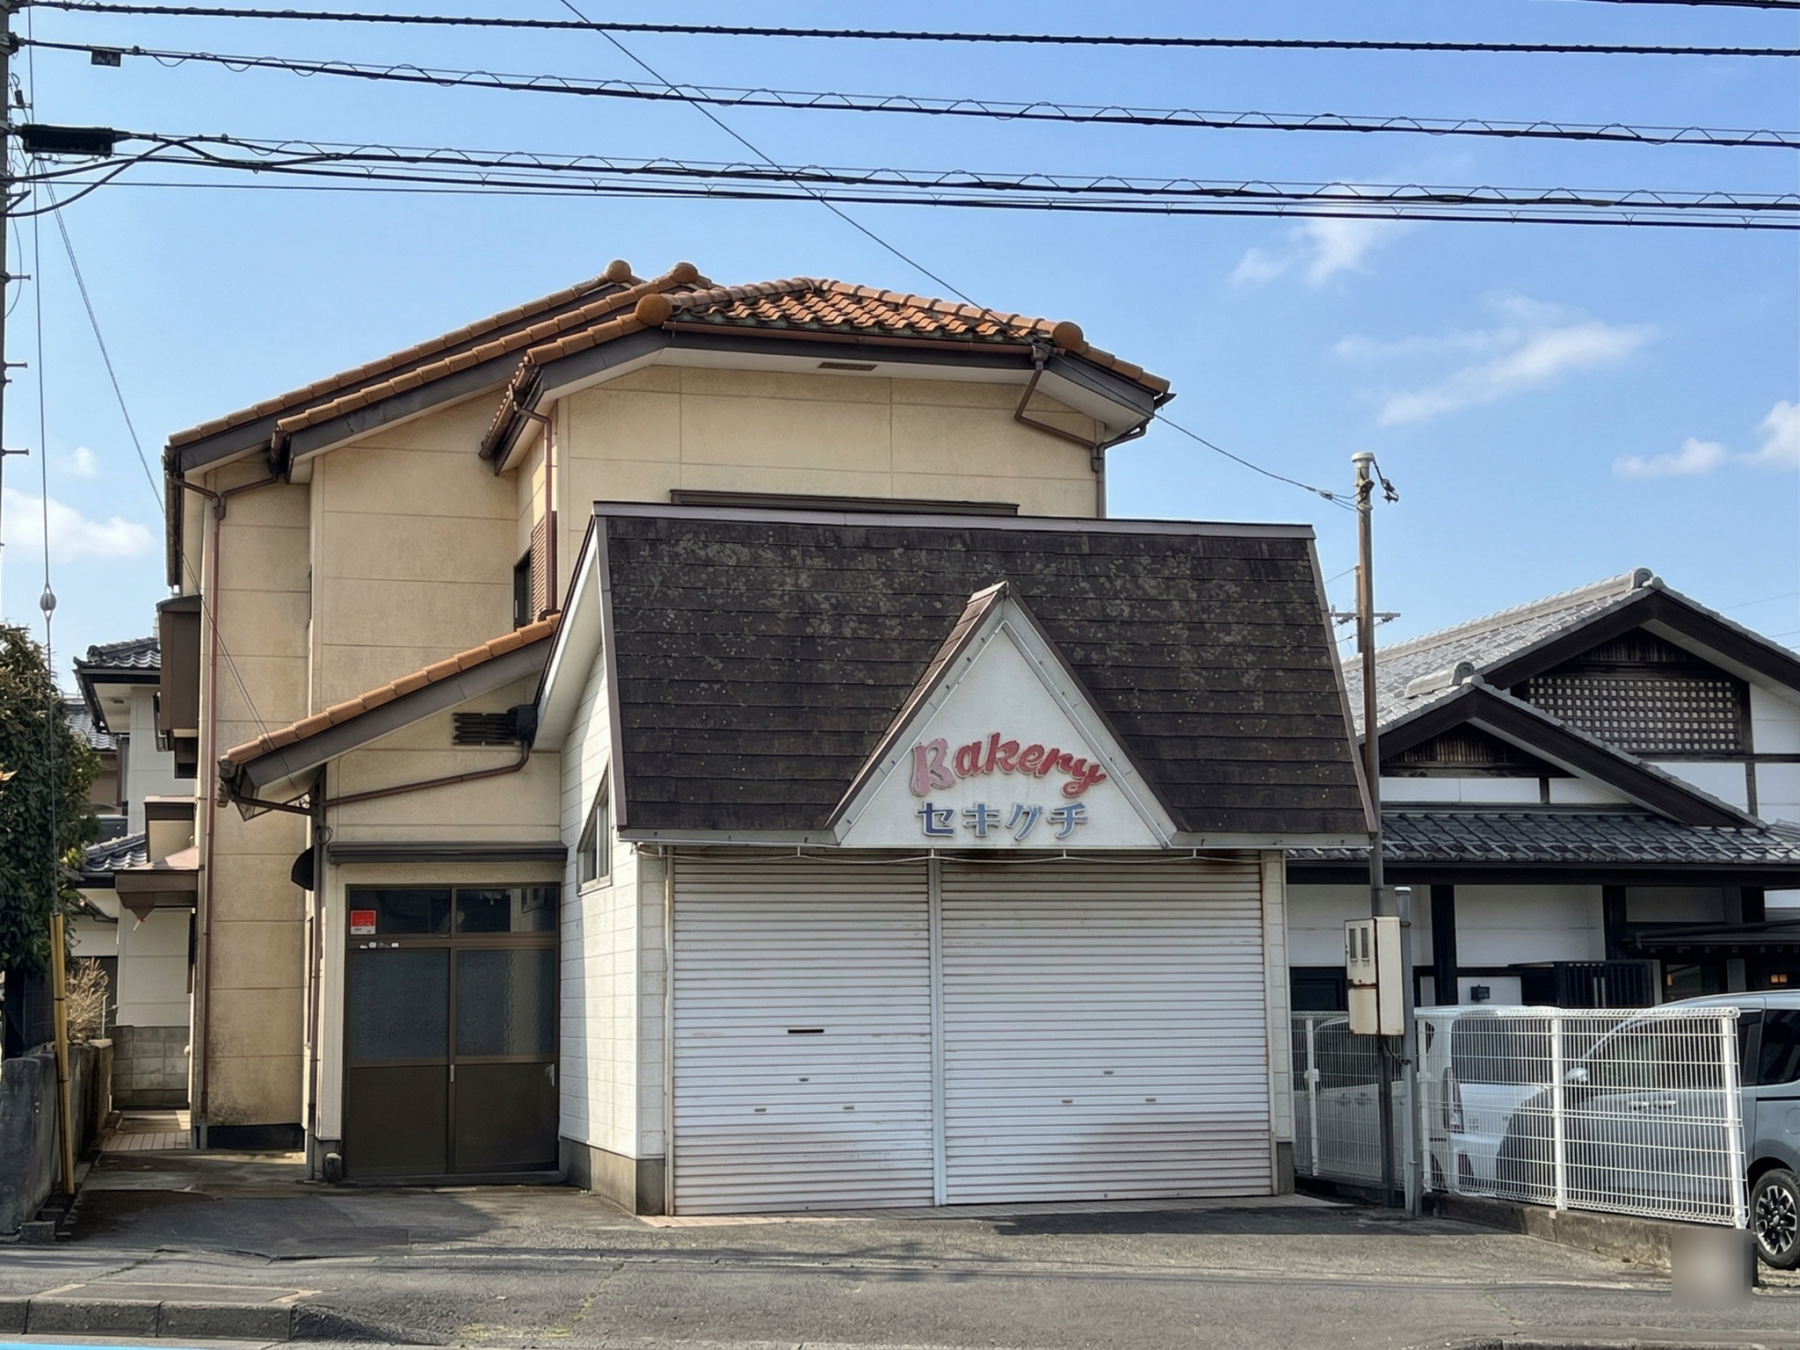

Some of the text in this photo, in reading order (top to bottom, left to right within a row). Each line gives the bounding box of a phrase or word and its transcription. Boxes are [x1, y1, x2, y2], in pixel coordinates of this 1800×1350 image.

[911, 731, 1107, 797] Bakery
[916, 802, 1089, 840] セキグチ
